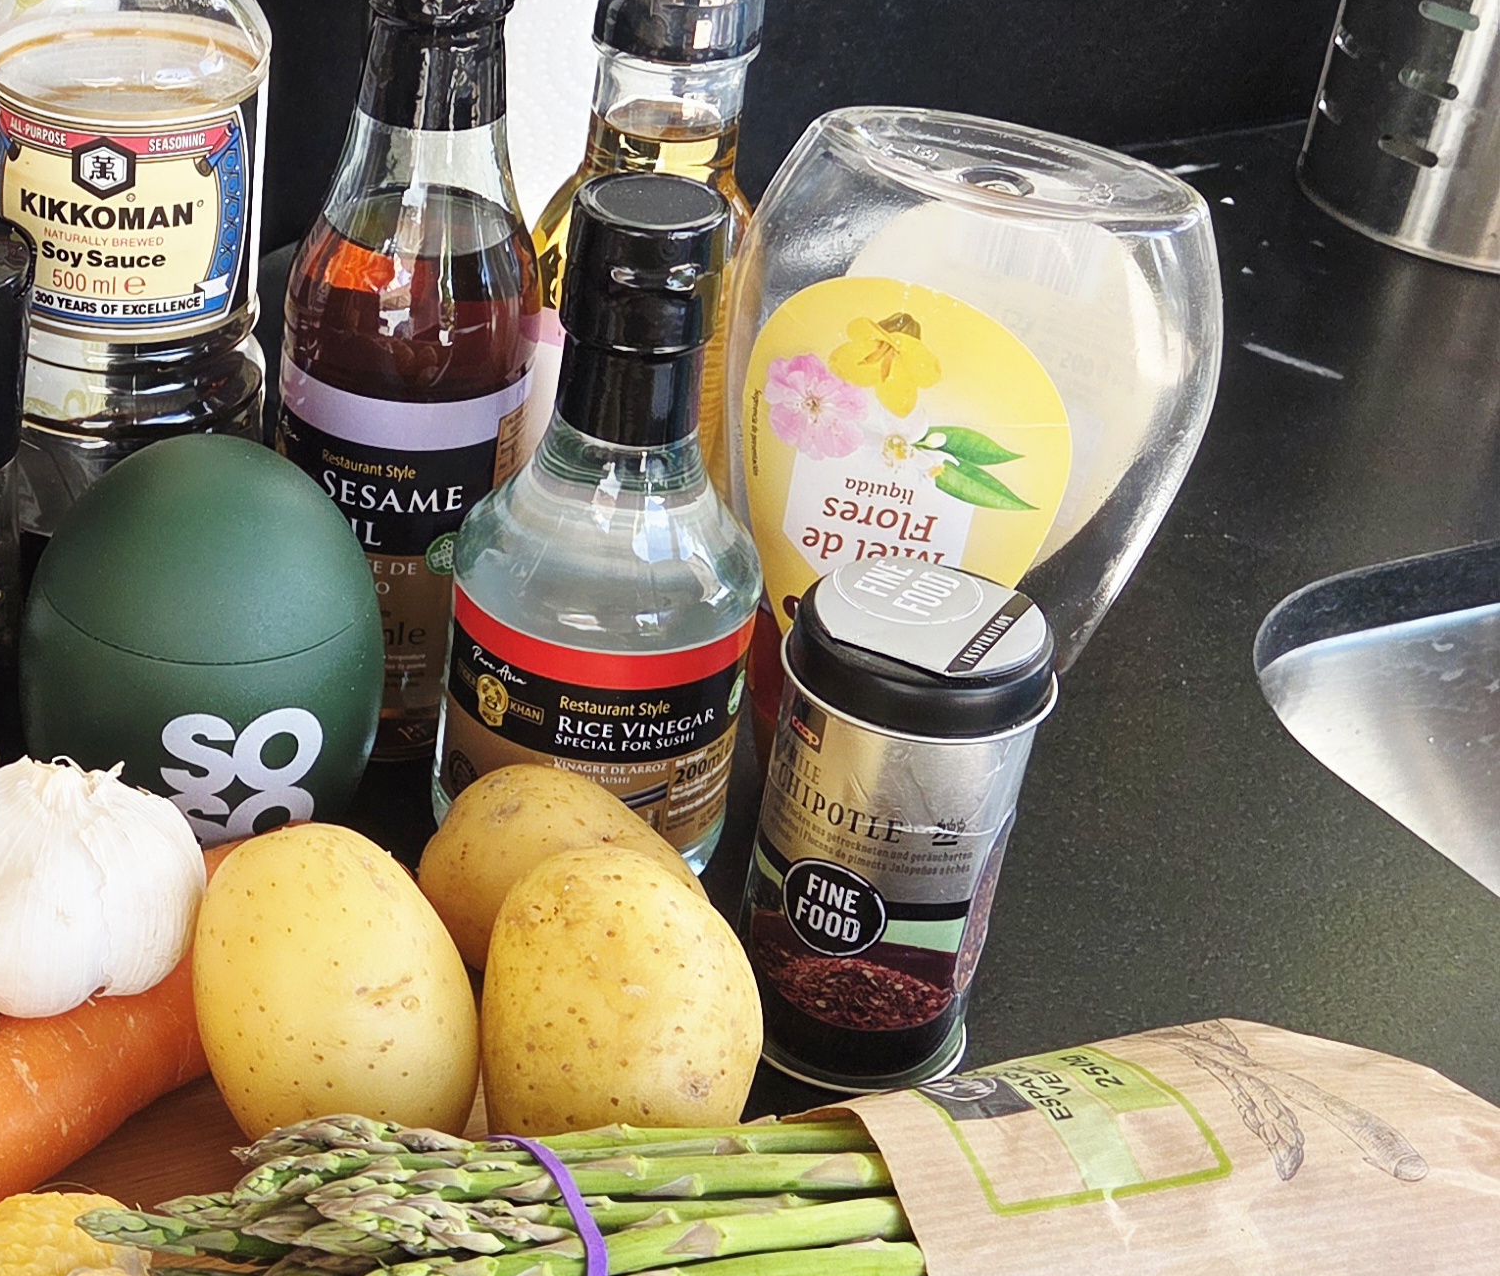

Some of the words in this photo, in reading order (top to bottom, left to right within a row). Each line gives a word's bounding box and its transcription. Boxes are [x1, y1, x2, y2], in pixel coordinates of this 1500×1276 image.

[9, 117, 67, 146] ALL-PURPOSE
[148, 132, 206, 152] SEASONING
[20, 188, 194, 230] KIKKOMAN
[43, 227, 109, 247] NATURALLY
[112, 237, 164, 247] BREWED
[41, 240, 83, 268] Soy
[87, 250, 166, 269] Sauce
[52, 269, 87, 292] 500
[92, 275, 116, 295] ml
[34, 290, 54, 306] 300
[57, 296, 97, 314] YEARS
[101, 304, 117, 315] OF
[122, 296, 201, 316] EXCELLENCE
[321, 448, 383, 477] Restaurant
[385, 464, 417, 482] Style
[323, 470, 463, 513] SESAME
[845, 477, 915, 505] líquida
[351, 518, 382, 546] IL
[822, 497, 939, 543] Flores
[802, 526, 844, 560] de
[390, 562, 417, 575] DE
[853, 558, 914, 598] FINE
[892, 572, 962, 617] FOOD
[960, 613, 1015, 666] INSPIRATION
[509, 701, 541, 722] KHAN
[557, 715, 613, 739] RICE
[622, 707, 716, 739] VINEGAR
[559, 695, 635, 717] Restaurant
[638, 700, 671, 719] Style
[160, 707, 323, 792] SO
[554, 733, 617, 752] SPECIAL
[621, 740, 651, 751] FOR
[655, 731, 695, 750] SUSHI
[553, 757, 606, 775] VINAGRE
[610, 765, 626, 775] DE
[628, 762, 668, 775] ARROZ
[778, 762, 905, 845] CHIPOTLE
[806, 872, 861, 915] FINE
[795, 895, 861, 944] FOOD
